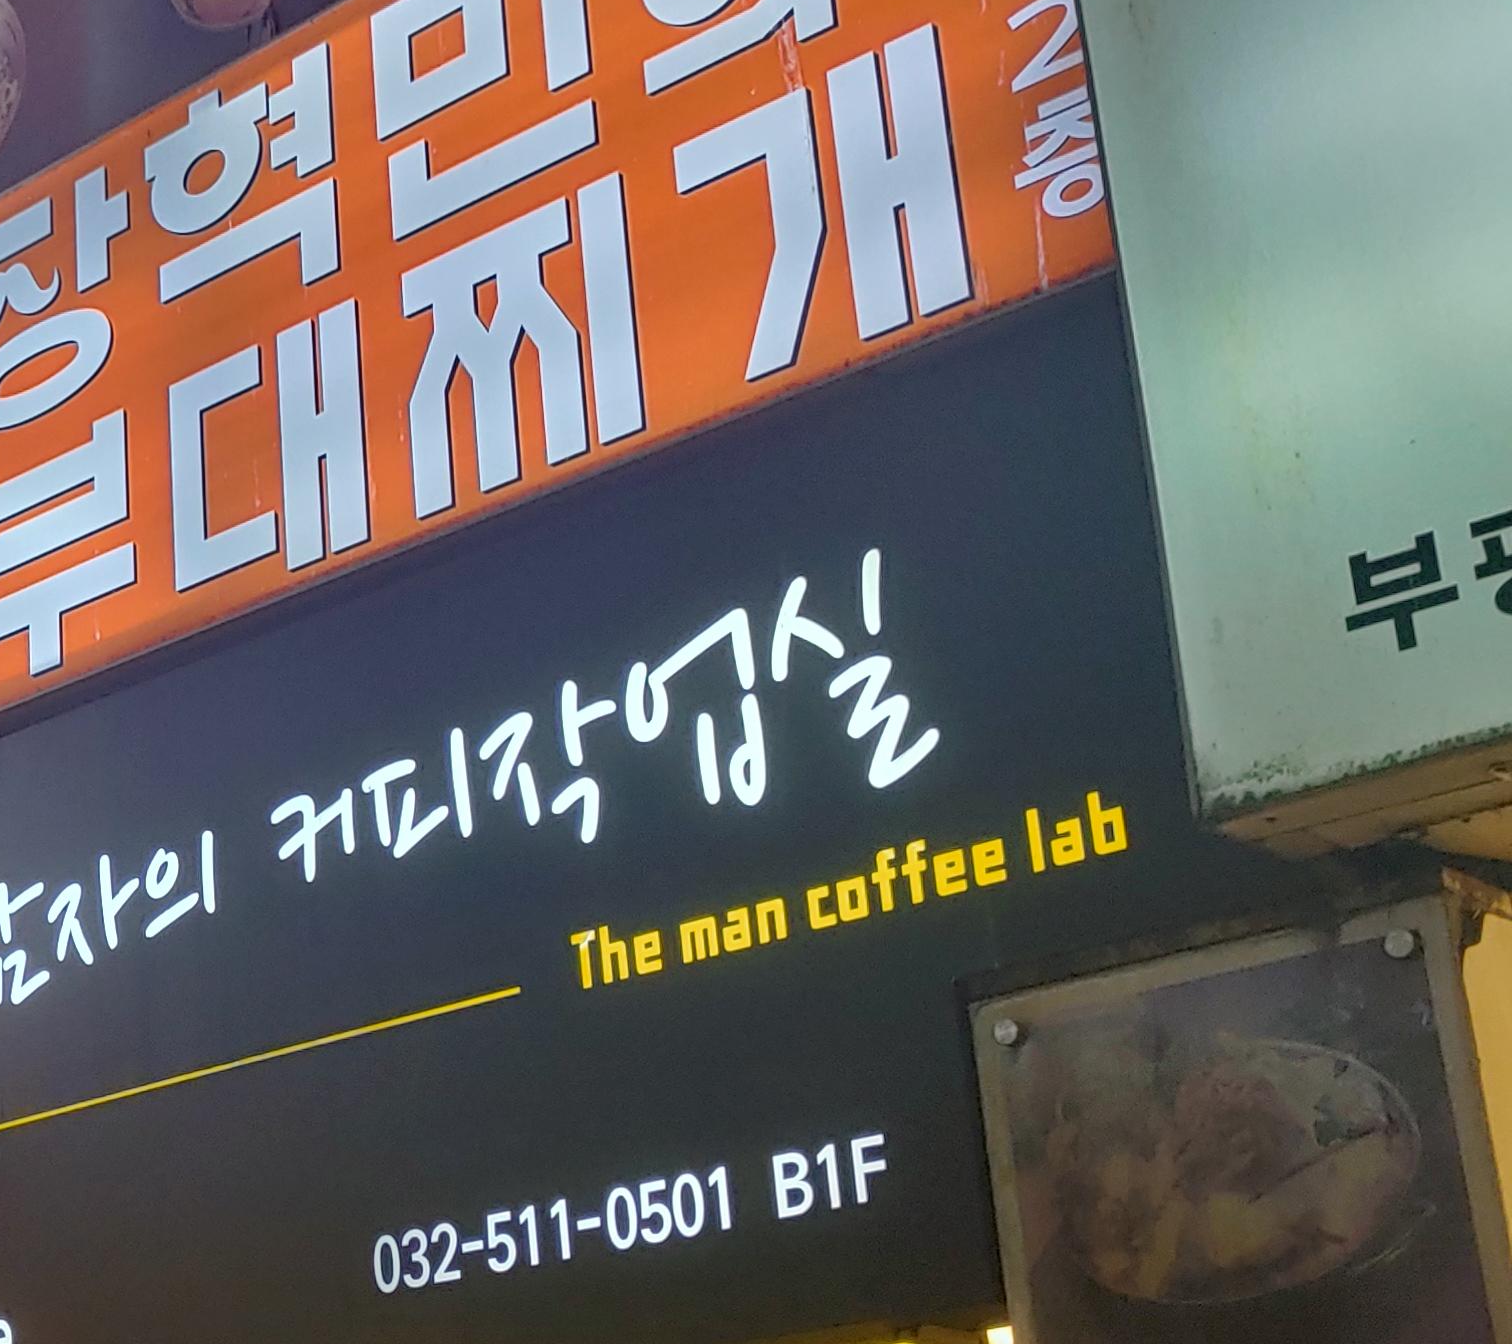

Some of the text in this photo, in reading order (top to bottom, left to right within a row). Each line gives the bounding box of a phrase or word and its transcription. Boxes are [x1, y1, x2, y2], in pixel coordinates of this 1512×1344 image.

[270, 548, 941, 883] 커피작업실
[572, 790, 1129, 991] The man coffee lab
[374, 1133, 888, 1295] 032-511-0501 B1F
